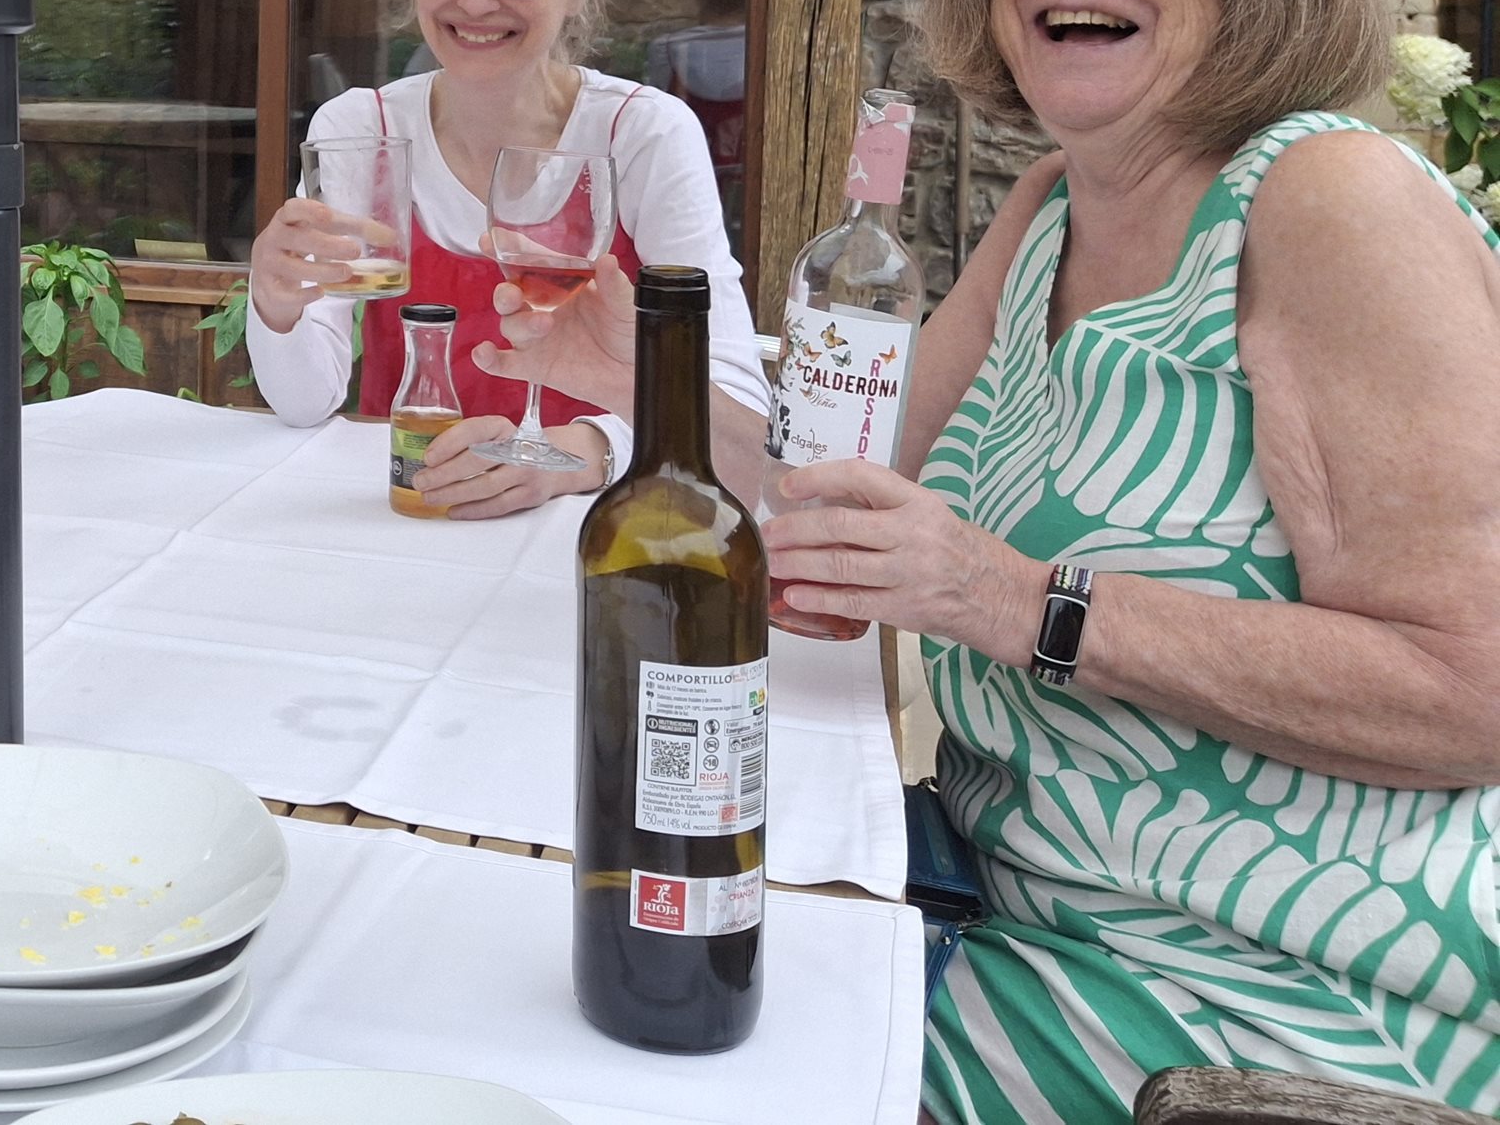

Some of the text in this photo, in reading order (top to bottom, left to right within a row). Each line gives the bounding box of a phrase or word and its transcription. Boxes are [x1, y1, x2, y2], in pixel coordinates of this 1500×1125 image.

[803, 365, 897, 398] CALDERONA
[857, 359, 881, 459] ROSAD
[647, 670, 733, 685] COMPORTILLO
[699, 772, 730, 781] RIOJA
